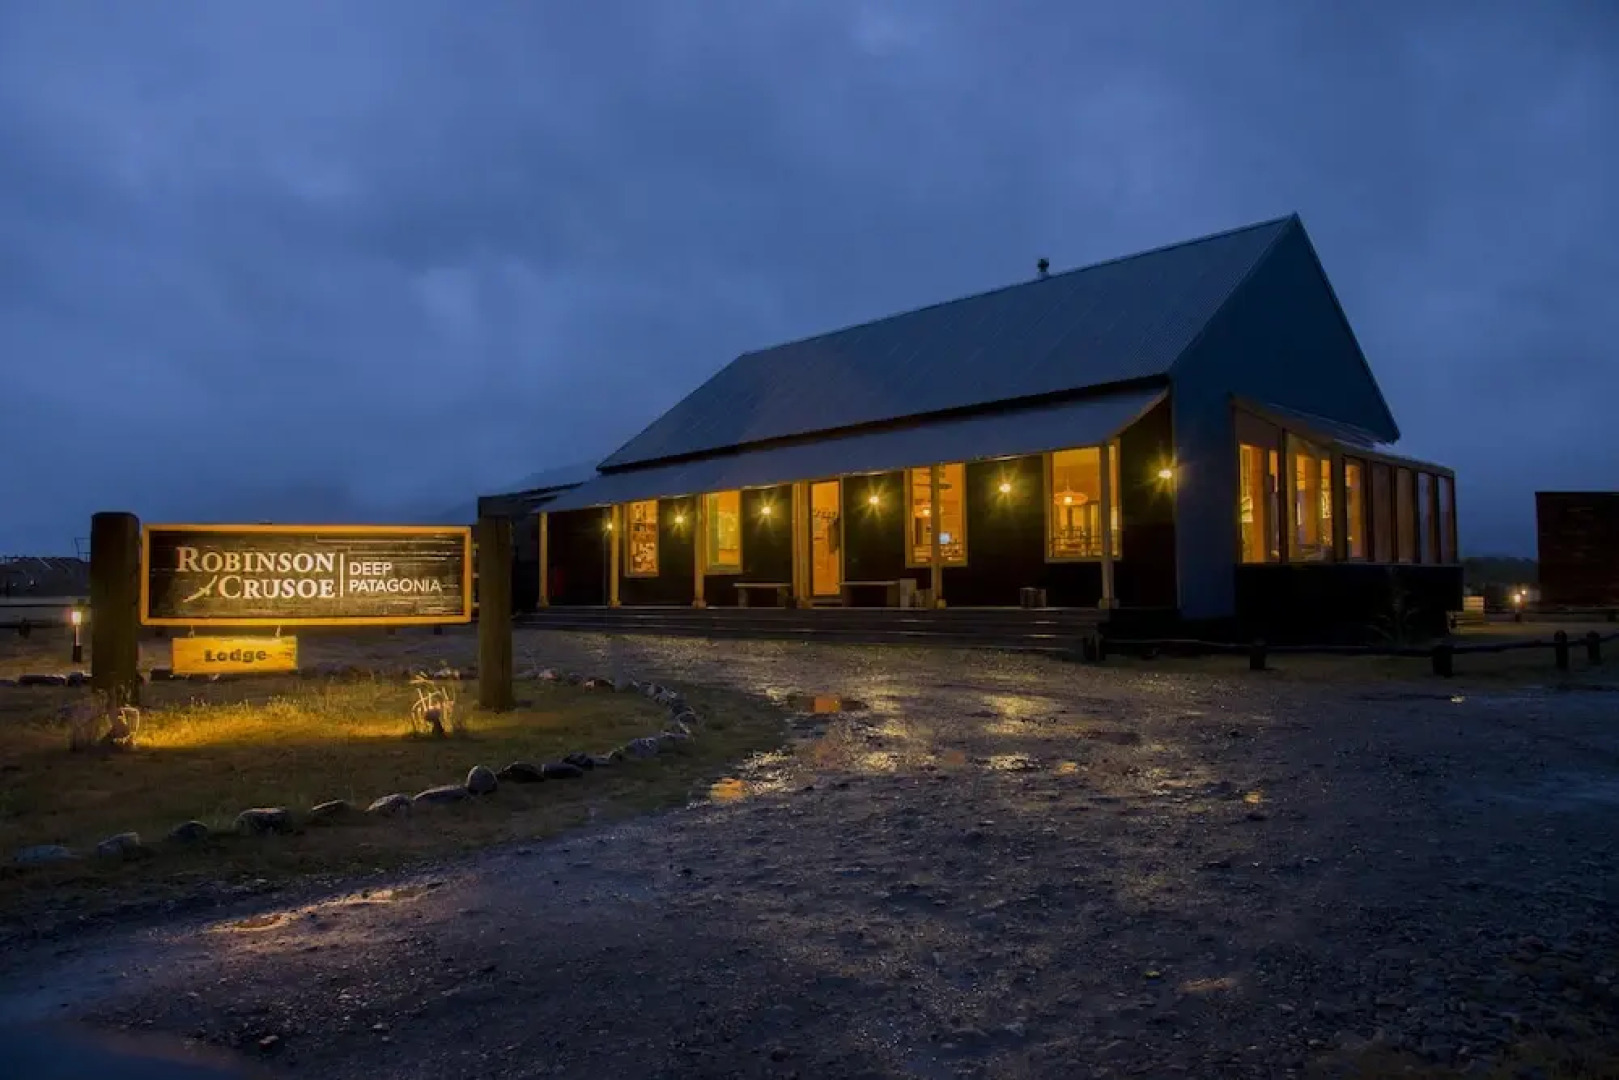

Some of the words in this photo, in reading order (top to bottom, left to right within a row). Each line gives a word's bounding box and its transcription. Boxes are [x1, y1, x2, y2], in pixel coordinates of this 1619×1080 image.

[176, 547, 335, 573] ROBINSON
[349, 561, 393, 576] DEEP
[218, 575, 335, 599] CRUSOE
[349, 578, 442, 593] PATAGONIA
[204, 648, 267, 664] Lodge
